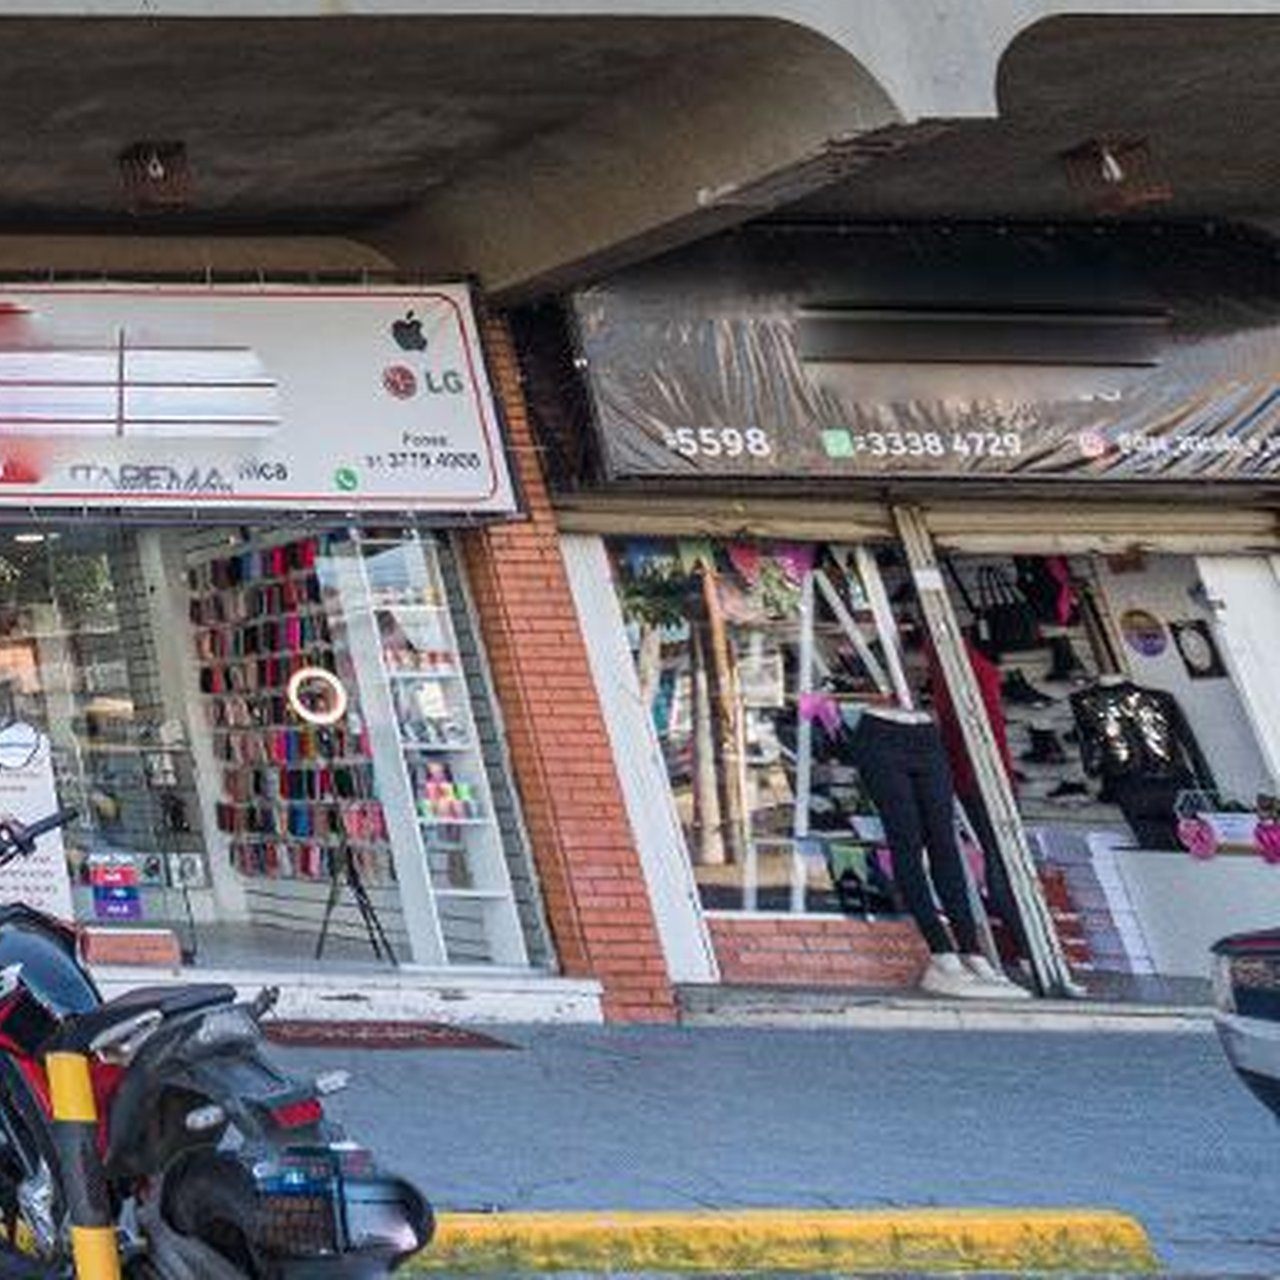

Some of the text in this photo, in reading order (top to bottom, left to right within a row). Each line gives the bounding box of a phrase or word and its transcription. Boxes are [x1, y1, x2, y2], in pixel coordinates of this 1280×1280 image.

[425, 370, 464, 394] LG
[676, 426, 771, 457] 5598
[869, 432, 944, 457] 3338
